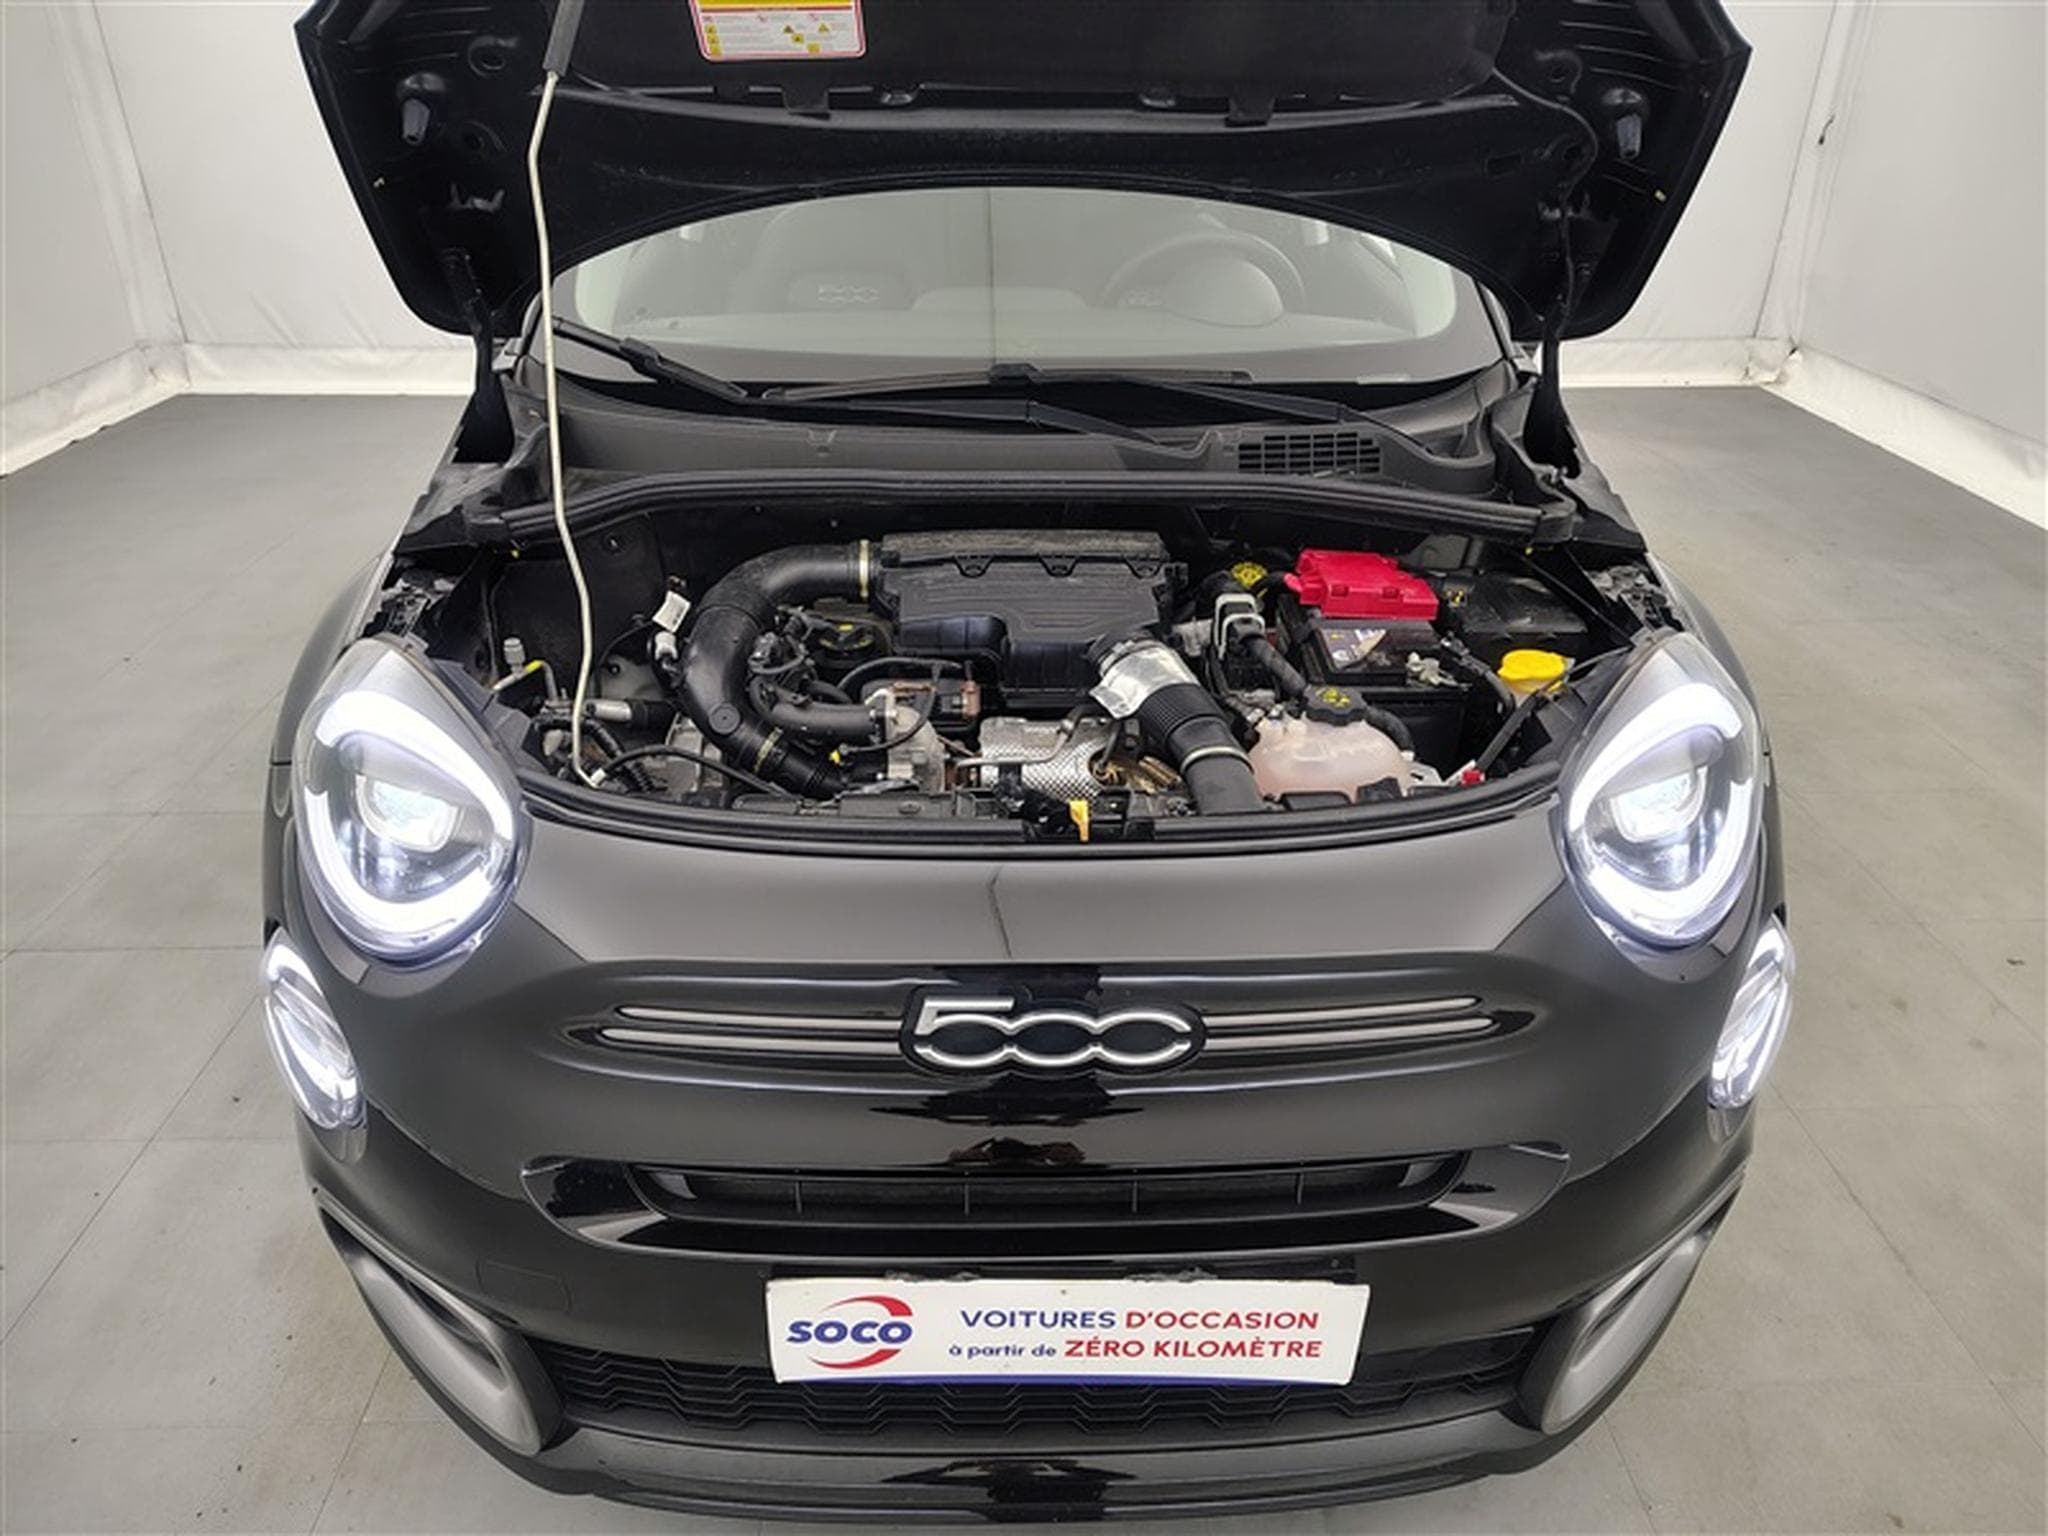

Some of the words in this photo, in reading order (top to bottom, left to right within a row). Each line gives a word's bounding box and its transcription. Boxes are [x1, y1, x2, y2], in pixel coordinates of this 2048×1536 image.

[913, 997, 1191, 1067] 500
[960, 1310, 1117, 1328] VOITURES
[1125, 1311, 1319, 1329] D'OCCASION
[786, 1320, 913, 1344] SOCO
[949, 1343, 962, 1356] à
[967, 1343, 1025, 1360] partir
[1031, 1343, 1057, 1357] de
[1064, 1336, 1145, 1357] ZÉRO
[1153, 1336, 1323, 1358] KILOMÈTRE
